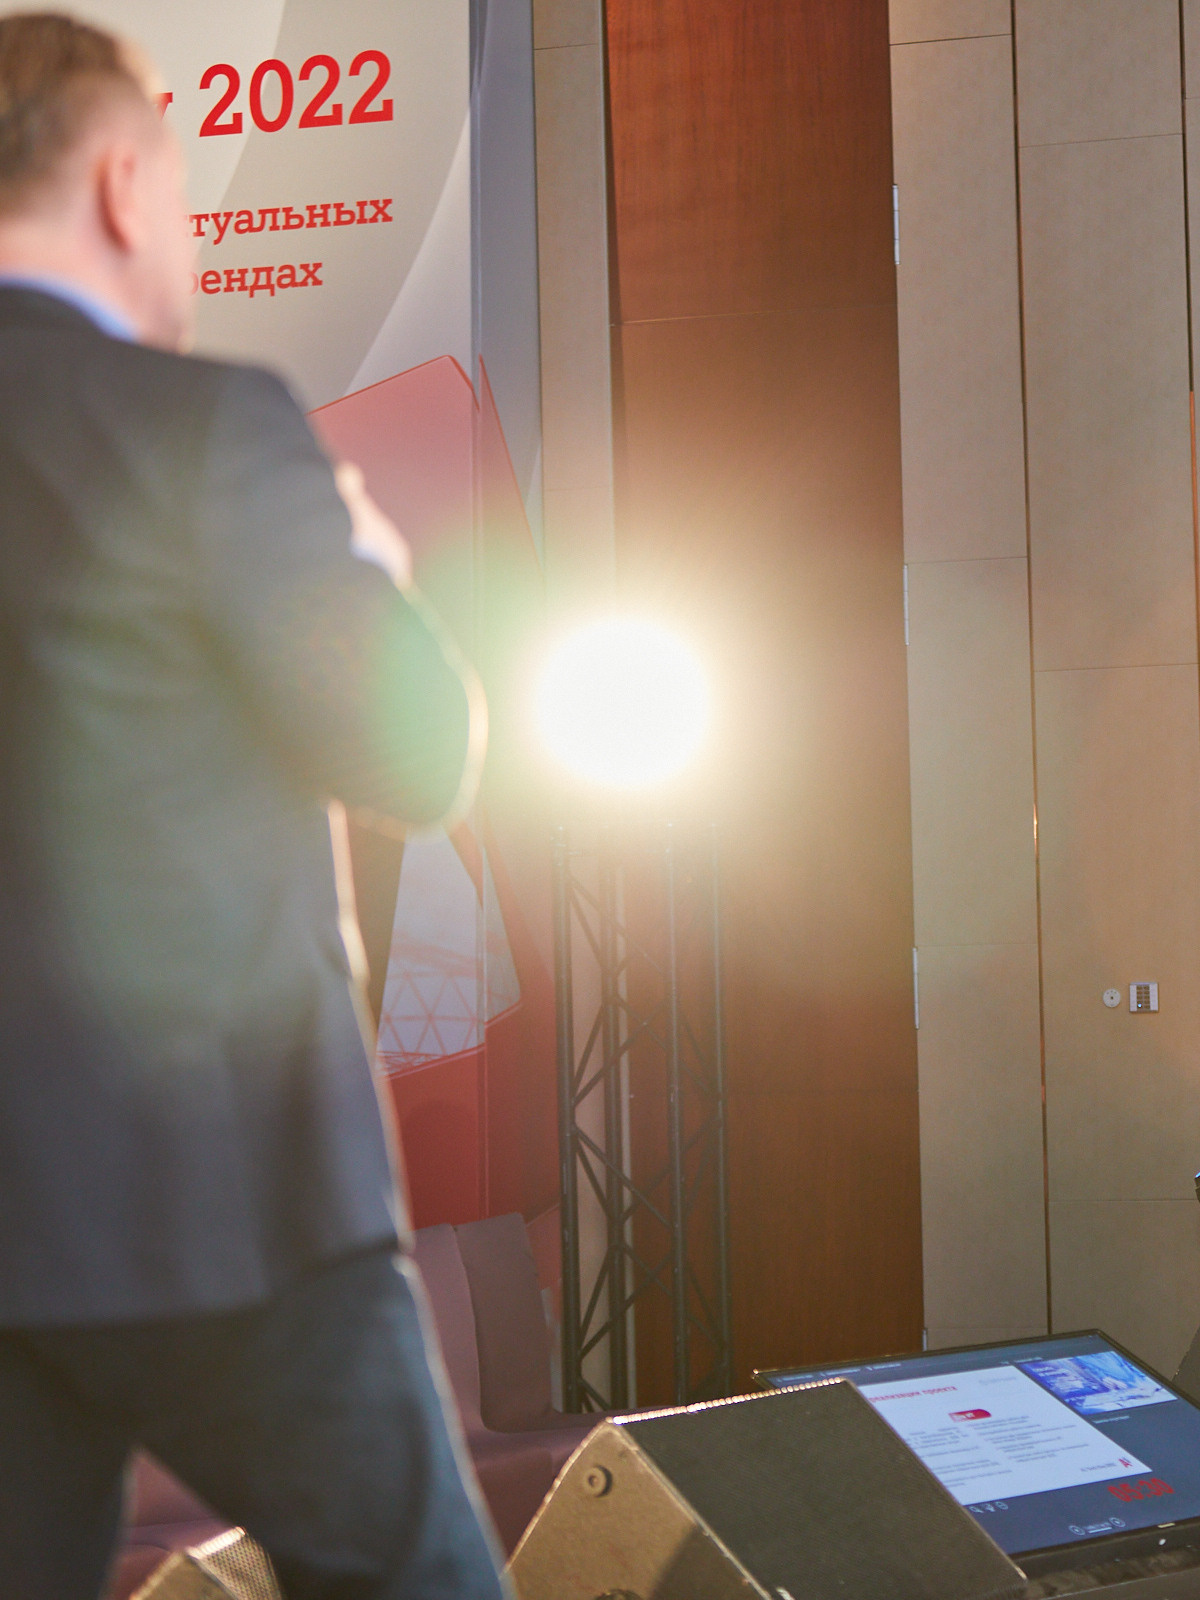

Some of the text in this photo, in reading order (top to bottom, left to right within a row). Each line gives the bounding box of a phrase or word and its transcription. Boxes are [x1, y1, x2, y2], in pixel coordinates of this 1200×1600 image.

[199, 49, 394, 137] 2022
[187, 198, 393, 245] туальных
[1107, 1478, 1174, 1502] 05:30
